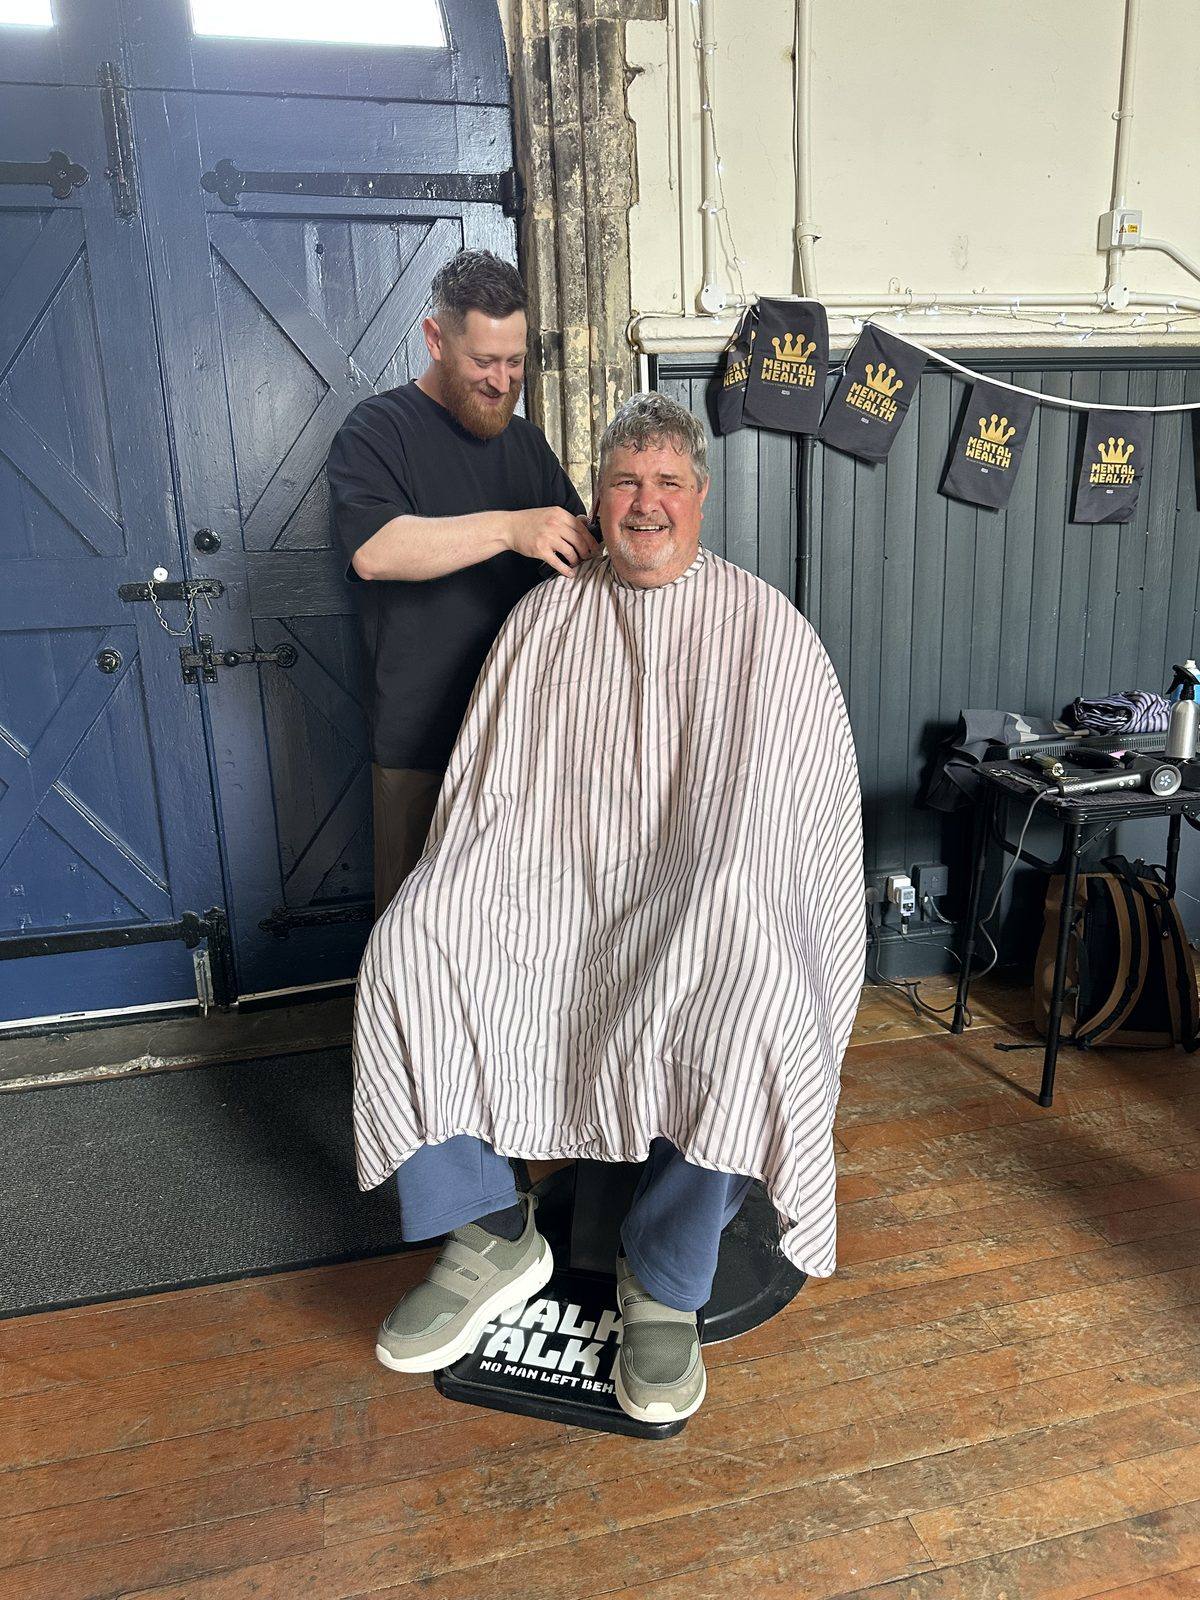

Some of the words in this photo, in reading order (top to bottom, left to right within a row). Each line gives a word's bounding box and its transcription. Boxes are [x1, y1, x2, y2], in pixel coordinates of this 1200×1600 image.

[763, 358, 816, 376] MENTAL
[724, 368, 749, 387] WEAL
[761, 368, 815, 387] WEALTH
[845, 392, 895, 422] WEALTH
[850, 382, 898, 412] MENTAL
[965, 446, 1011, 468] WEALTH
[967, 436, 1012, 458] MENTAL
[1089, 473, 1134, 484] WEALTH
[1091, 463, 1135, 474] MENTAL
[480, 1360, 502, 1373] NO
[503, 1364, 539, 1380] MAN
[540, 1371, 581, 1388] LEFT
[581, 1379, 616, 1395] BEH
